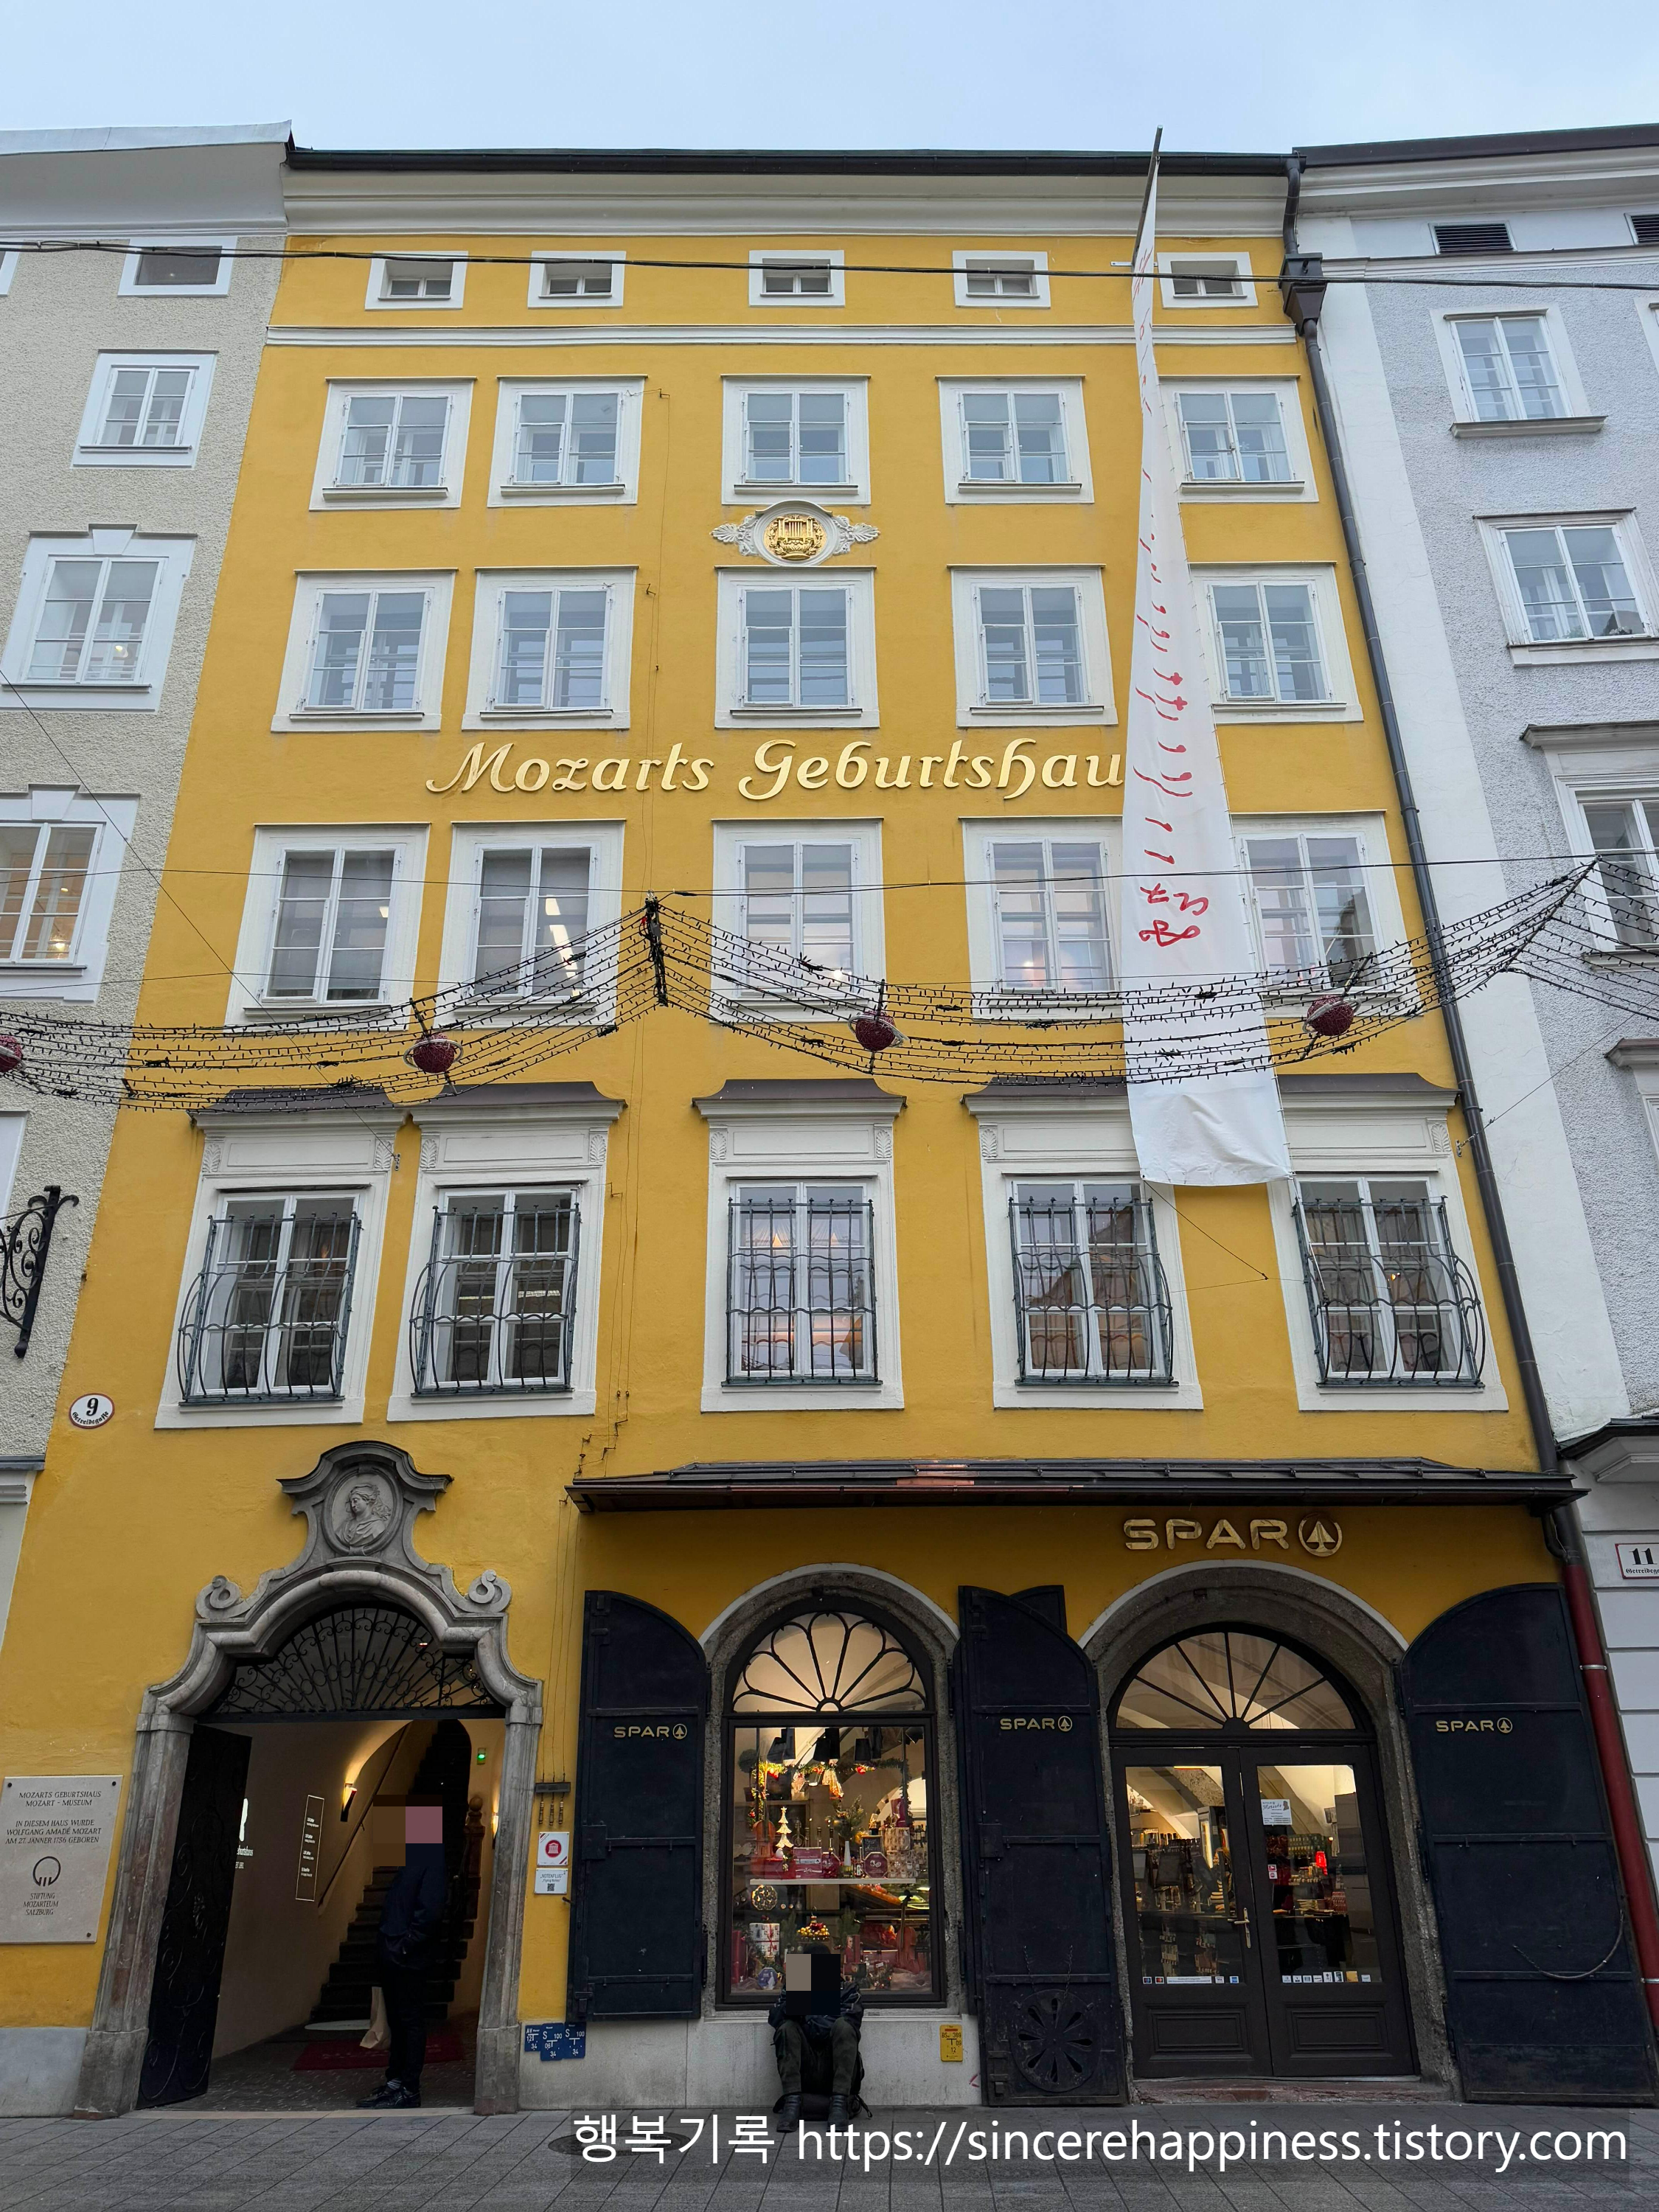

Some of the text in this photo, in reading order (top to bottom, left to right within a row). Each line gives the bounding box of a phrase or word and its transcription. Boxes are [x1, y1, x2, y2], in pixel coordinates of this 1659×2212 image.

[425, 737, 1124, 801] Mozarts Geburtshau
[86, 1397, 99, 1416] 9
[1123, 1519, 1289, 1550] SPAR
[1629, 1548, 1658, 1565] 11
[1000, 1718, 1055, 1730] SPAR
[1436, 1720, 1495, 1732] SPAR
[613, 1726, 669, 1738] SPAR
[543, 2031, 547, 2039] S
[566, 2029, 570, 2037] S
